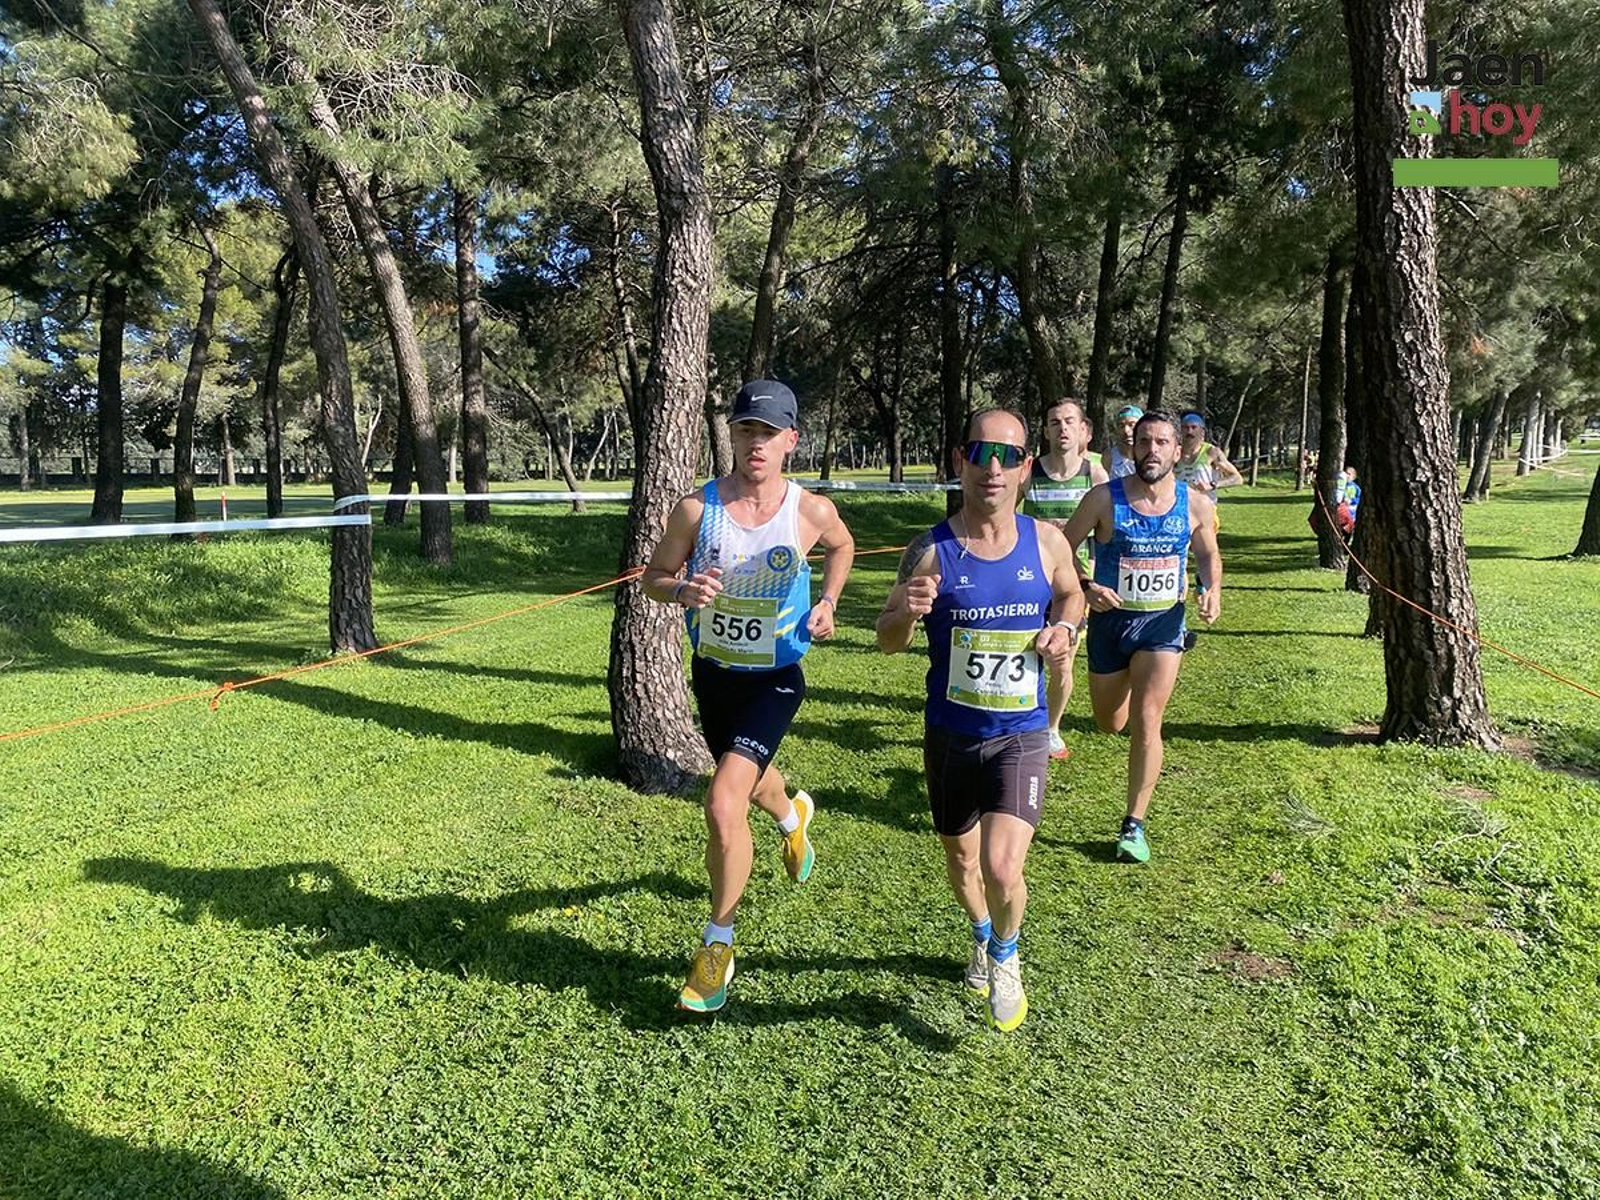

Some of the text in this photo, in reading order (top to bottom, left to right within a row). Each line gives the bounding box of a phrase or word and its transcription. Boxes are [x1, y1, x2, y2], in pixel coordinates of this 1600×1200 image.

[1124, 573, 1175, 592] 1056
[950, 603, 1039, 621] TROTASIERRA
[712, 613, 762, 641] 556
[965, 653, 1025, 682] 573
